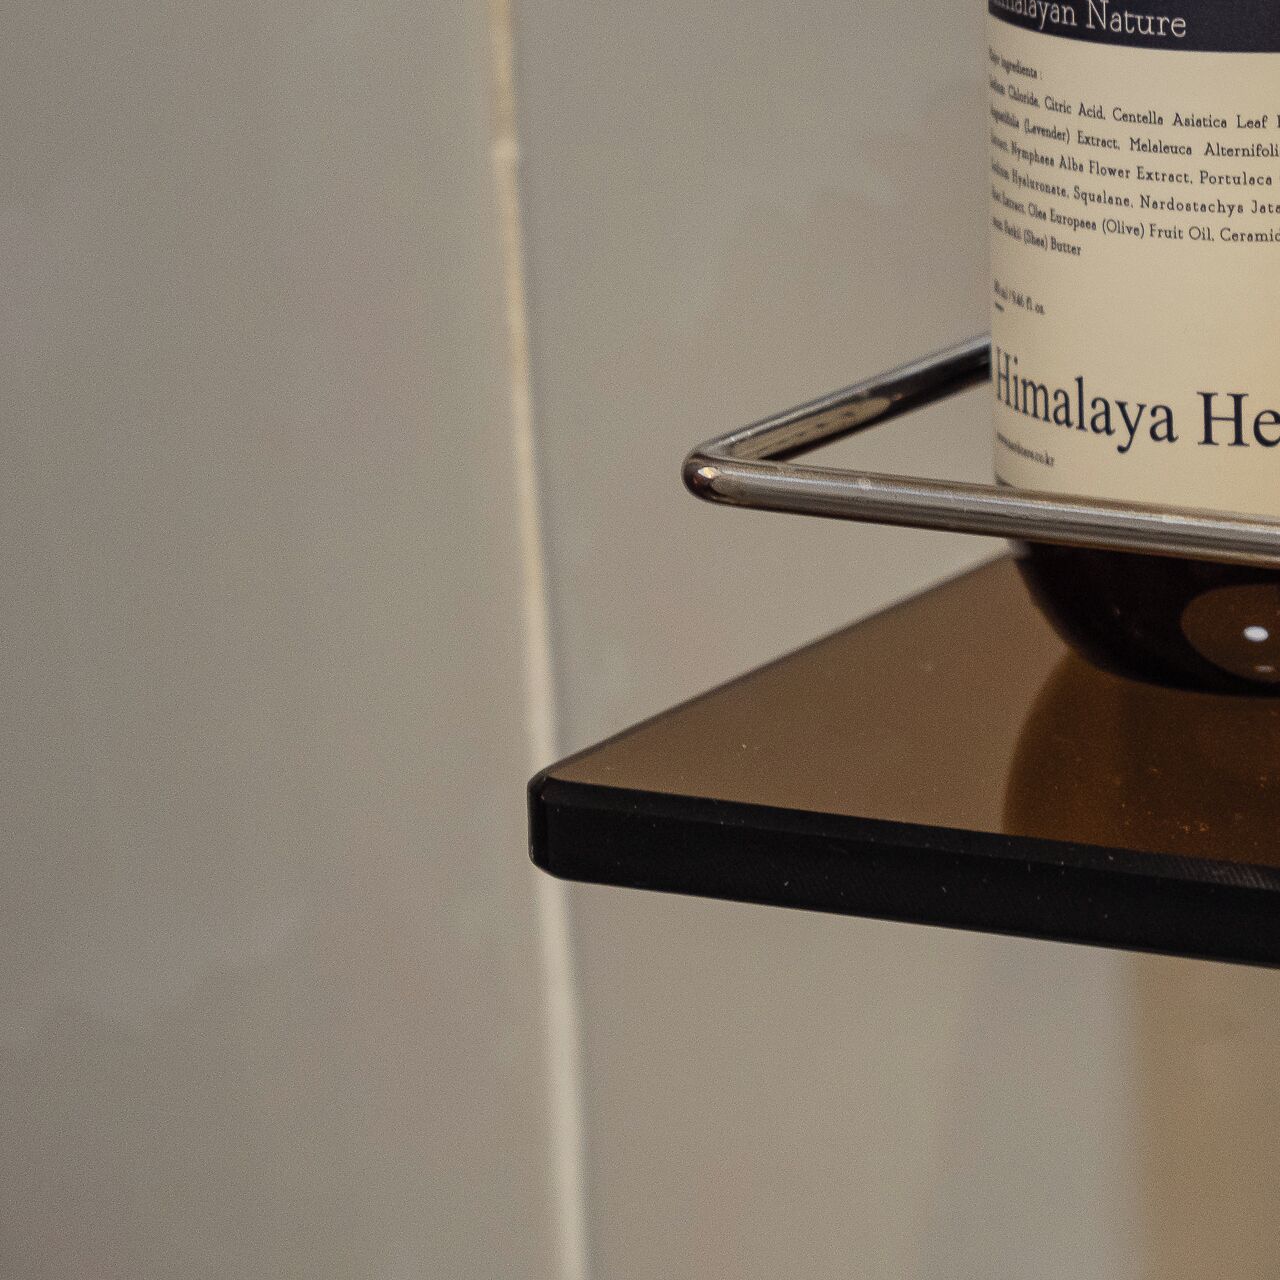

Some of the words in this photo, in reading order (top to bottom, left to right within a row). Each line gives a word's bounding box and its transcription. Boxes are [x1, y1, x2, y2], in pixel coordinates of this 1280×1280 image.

[1044, 95, 1072, 114] Citric
[1112, 106, 1164, 126] Centella
[1172, 112, 1228, 129] Asiatica
[1236, 114, 1268, 129] Leaf
[1129, 136, 1193, 156] Melaleuca
[1059, 154, 1084, 173] Alba
[1089, 160, 1131, 180] Flower
[1200, 170, 1273, 186] Portulaca
[1139, 194, 1244, 217] Nardostachys
[1050, 208, 1097, 231] Europaea
[1102, 218, 1145, 239] (Olive)
[1149, 223, 1184, 240] Fruit
[1051, 235, 1082, 256] Butter
[995, 346, 1179, 453] Himalaya
